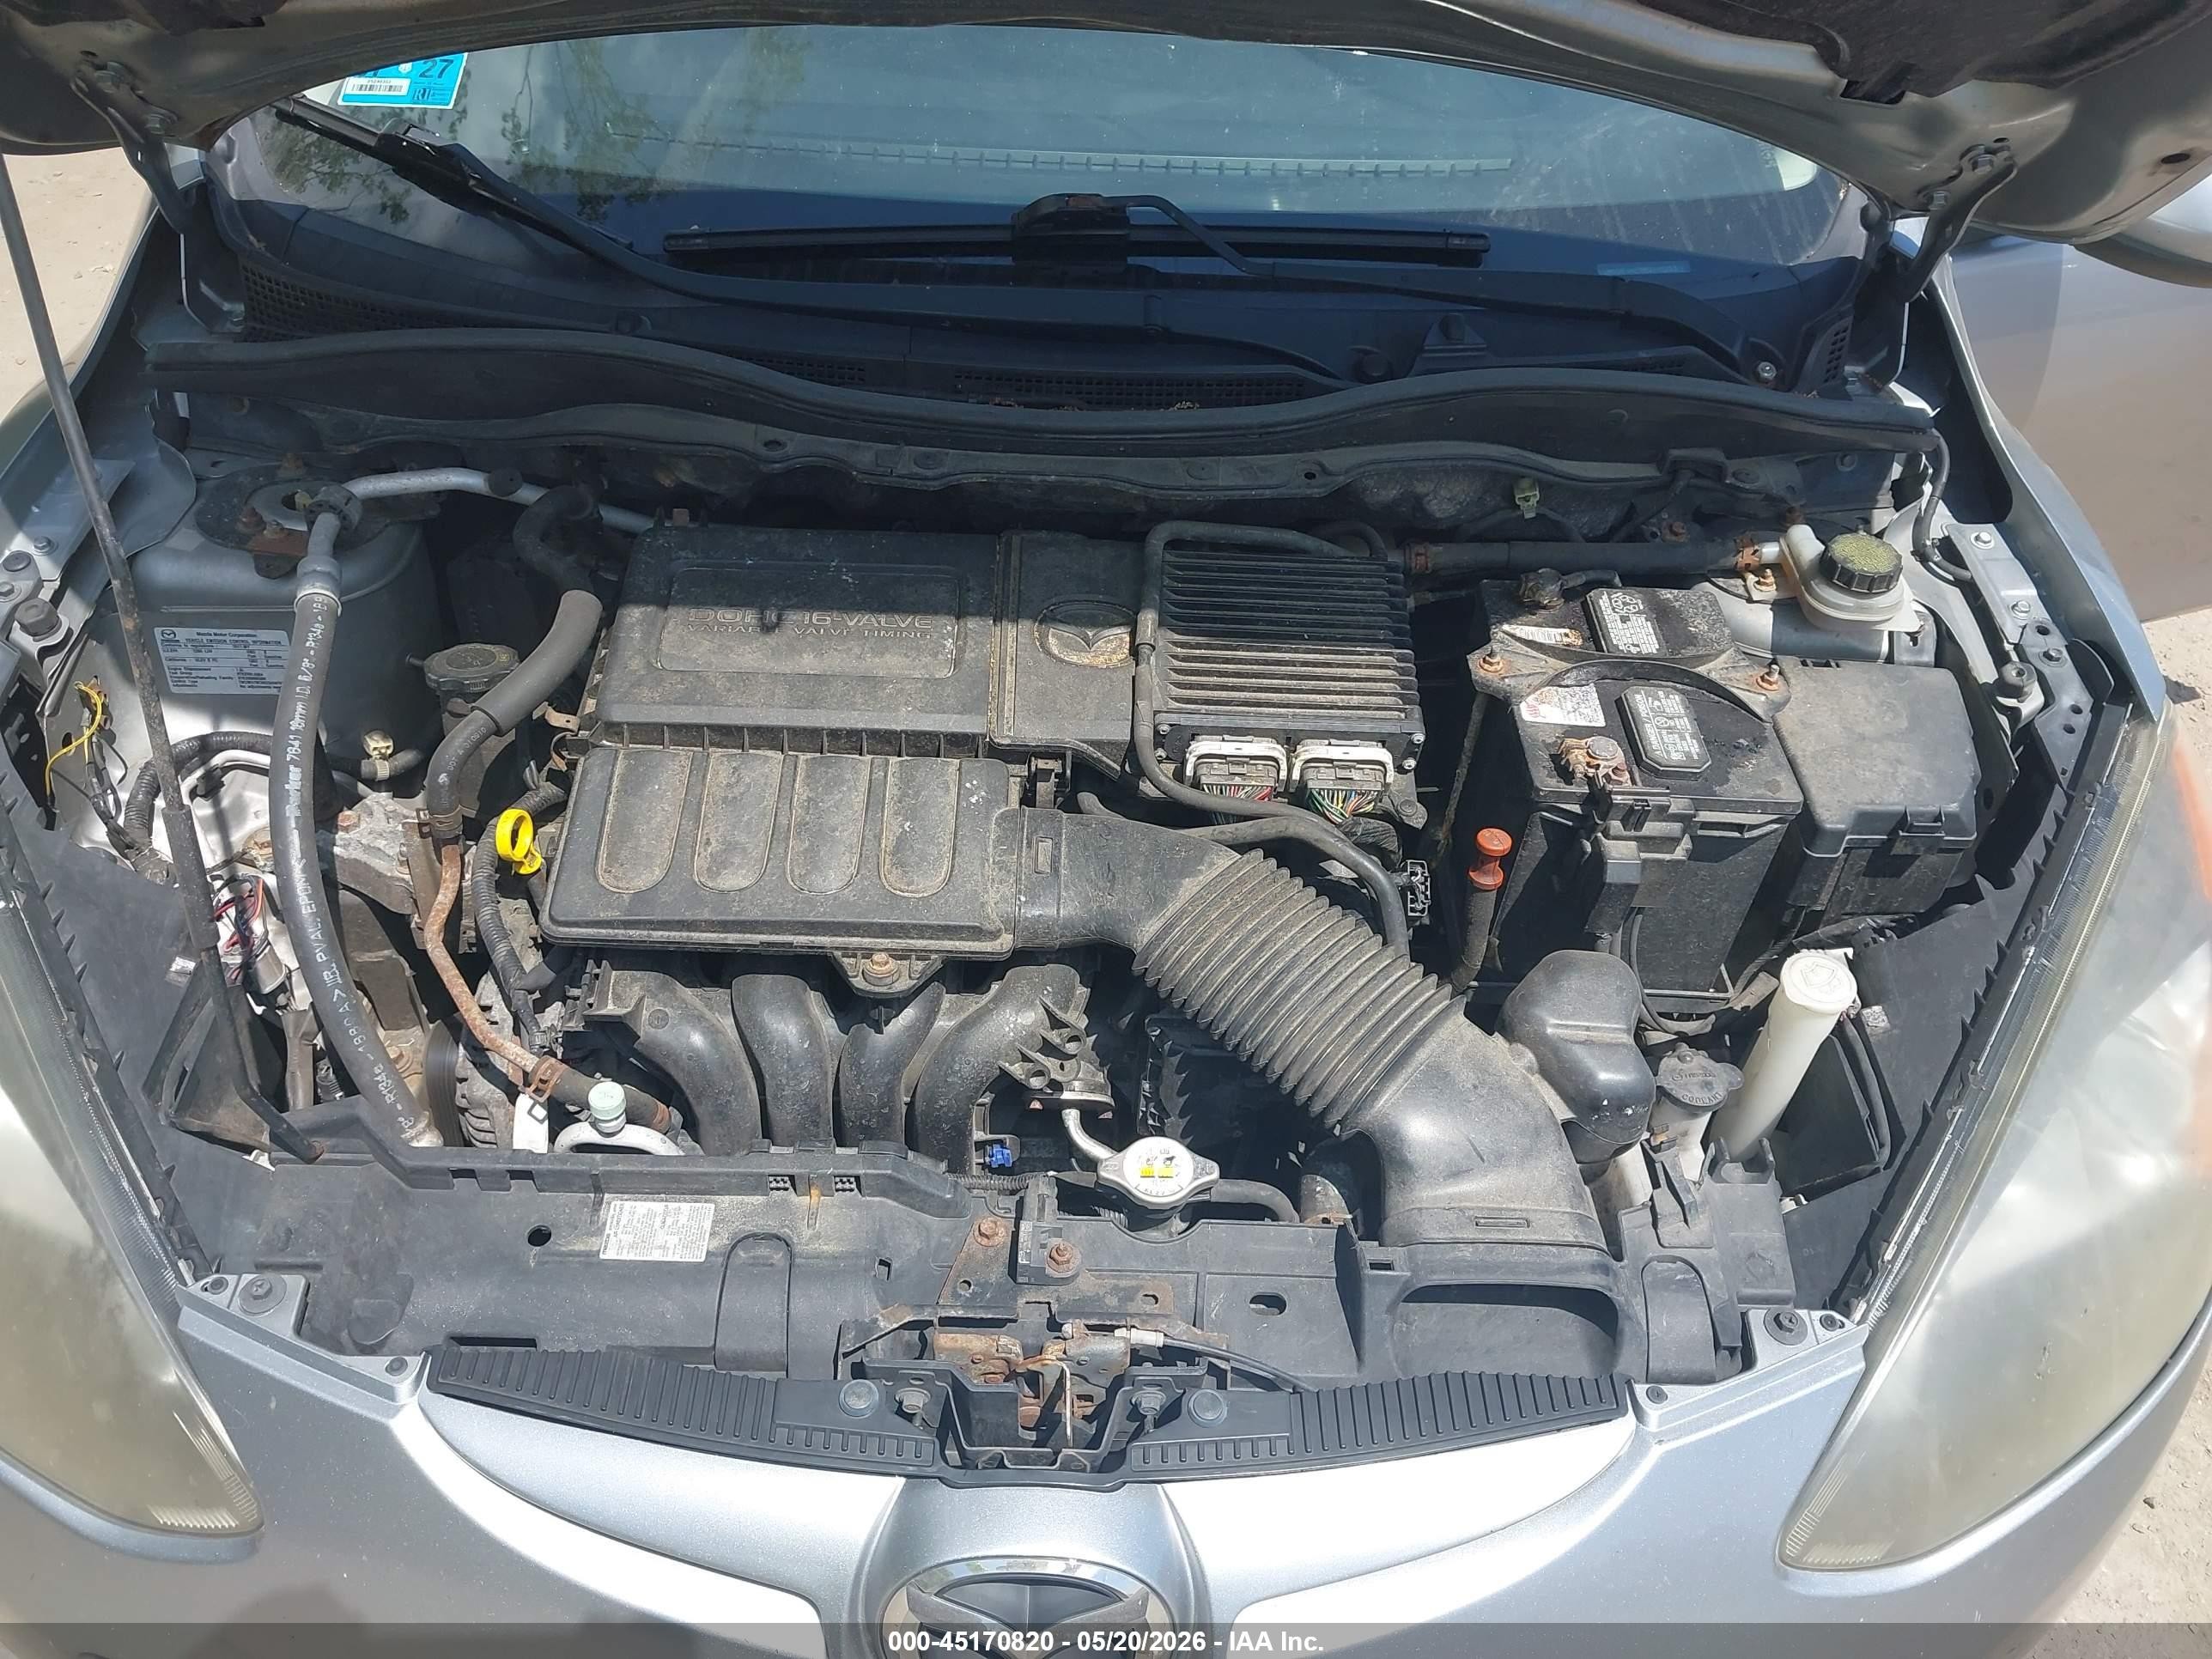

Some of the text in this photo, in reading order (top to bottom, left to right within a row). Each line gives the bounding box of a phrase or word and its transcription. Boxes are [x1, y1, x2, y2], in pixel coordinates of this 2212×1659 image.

[418, 58, 454, 79] 27
[688, 608, 933, 629] DOHC 16-VALVE
[687, 624, 783, 634] VARIABE
[863, 629, 932, 639] TIMING
[1633, 694, 1650, 718] POISON
[1644, 723, 1662, 750] DANGER
[285, 765, 302, 817] Parker
[1681, 1091, 1723, 1106] COOLANT
